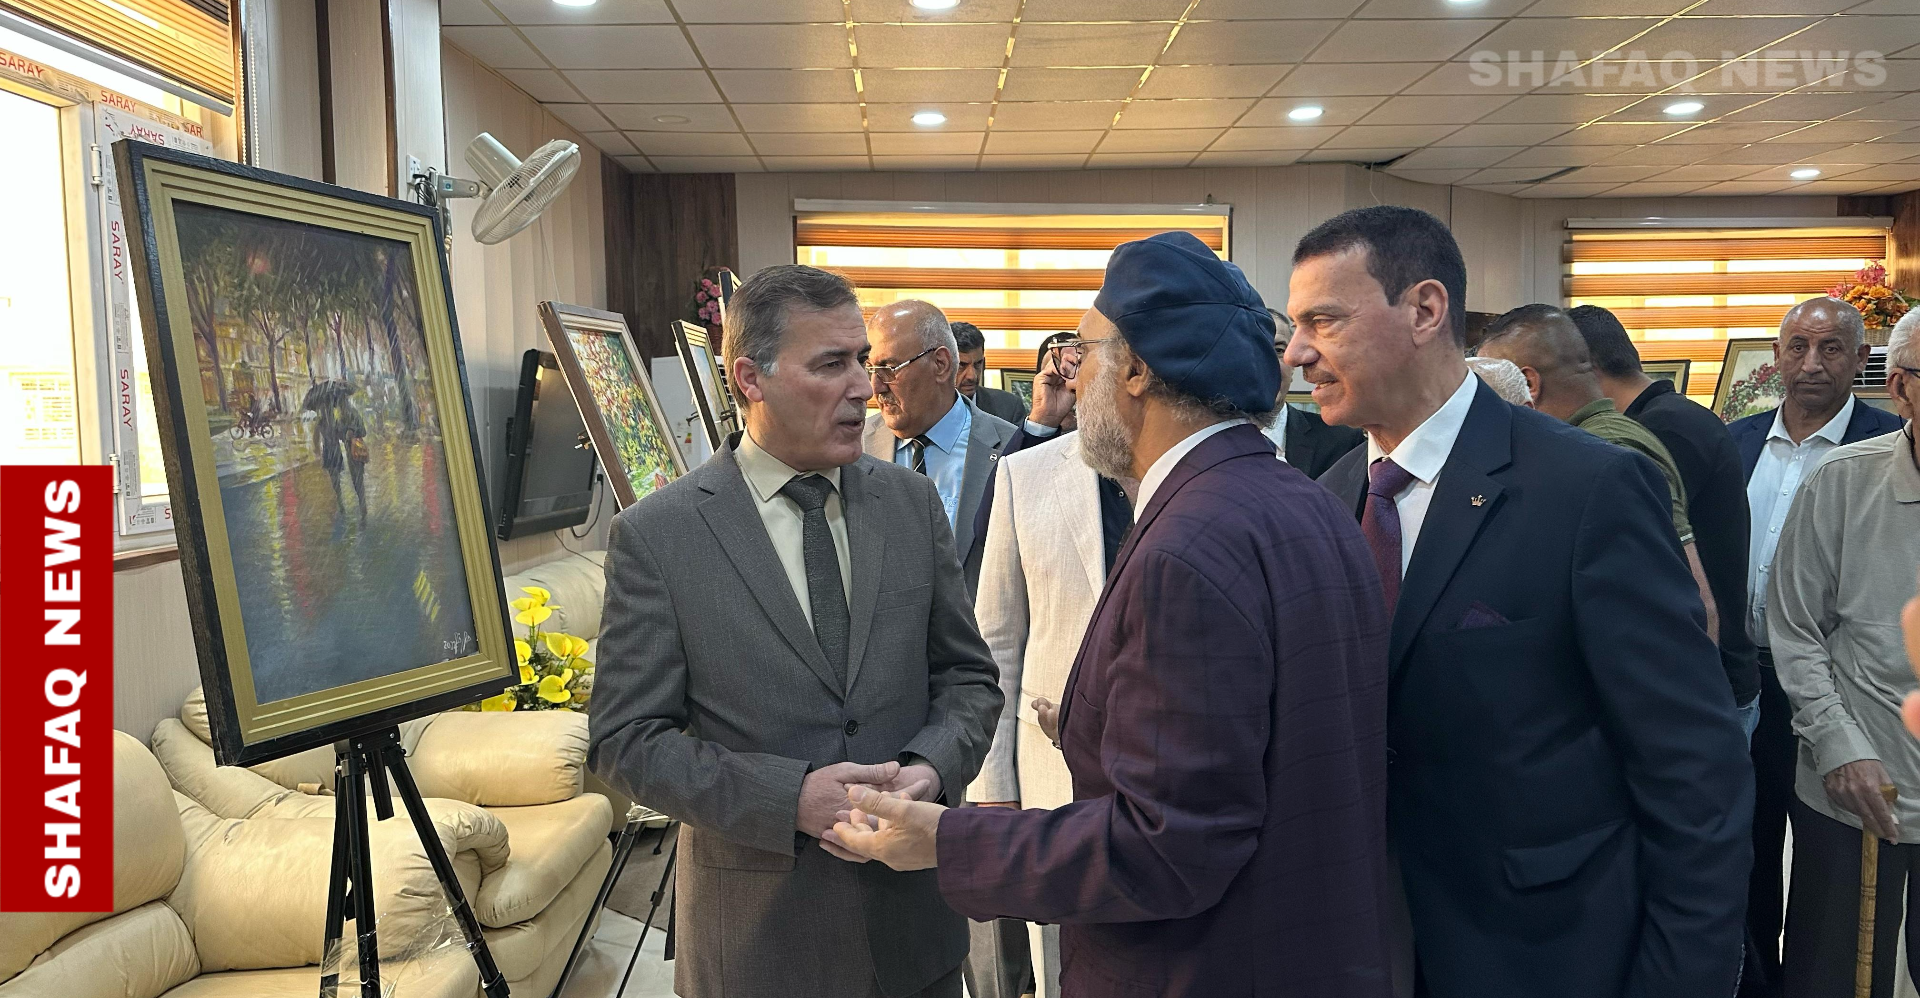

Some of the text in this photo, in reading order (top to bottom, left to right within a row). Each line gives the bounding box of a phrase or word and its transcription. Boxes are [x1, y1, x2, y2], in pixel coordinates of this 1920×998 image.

[0, 52, 45, 78] SARAY
[101, 90, 136, 113] SARAY
[182, 122, 204, 139] SAR
[111, 220, 124, 284] SARAY
[120, 369, 133, 431] SARAY
